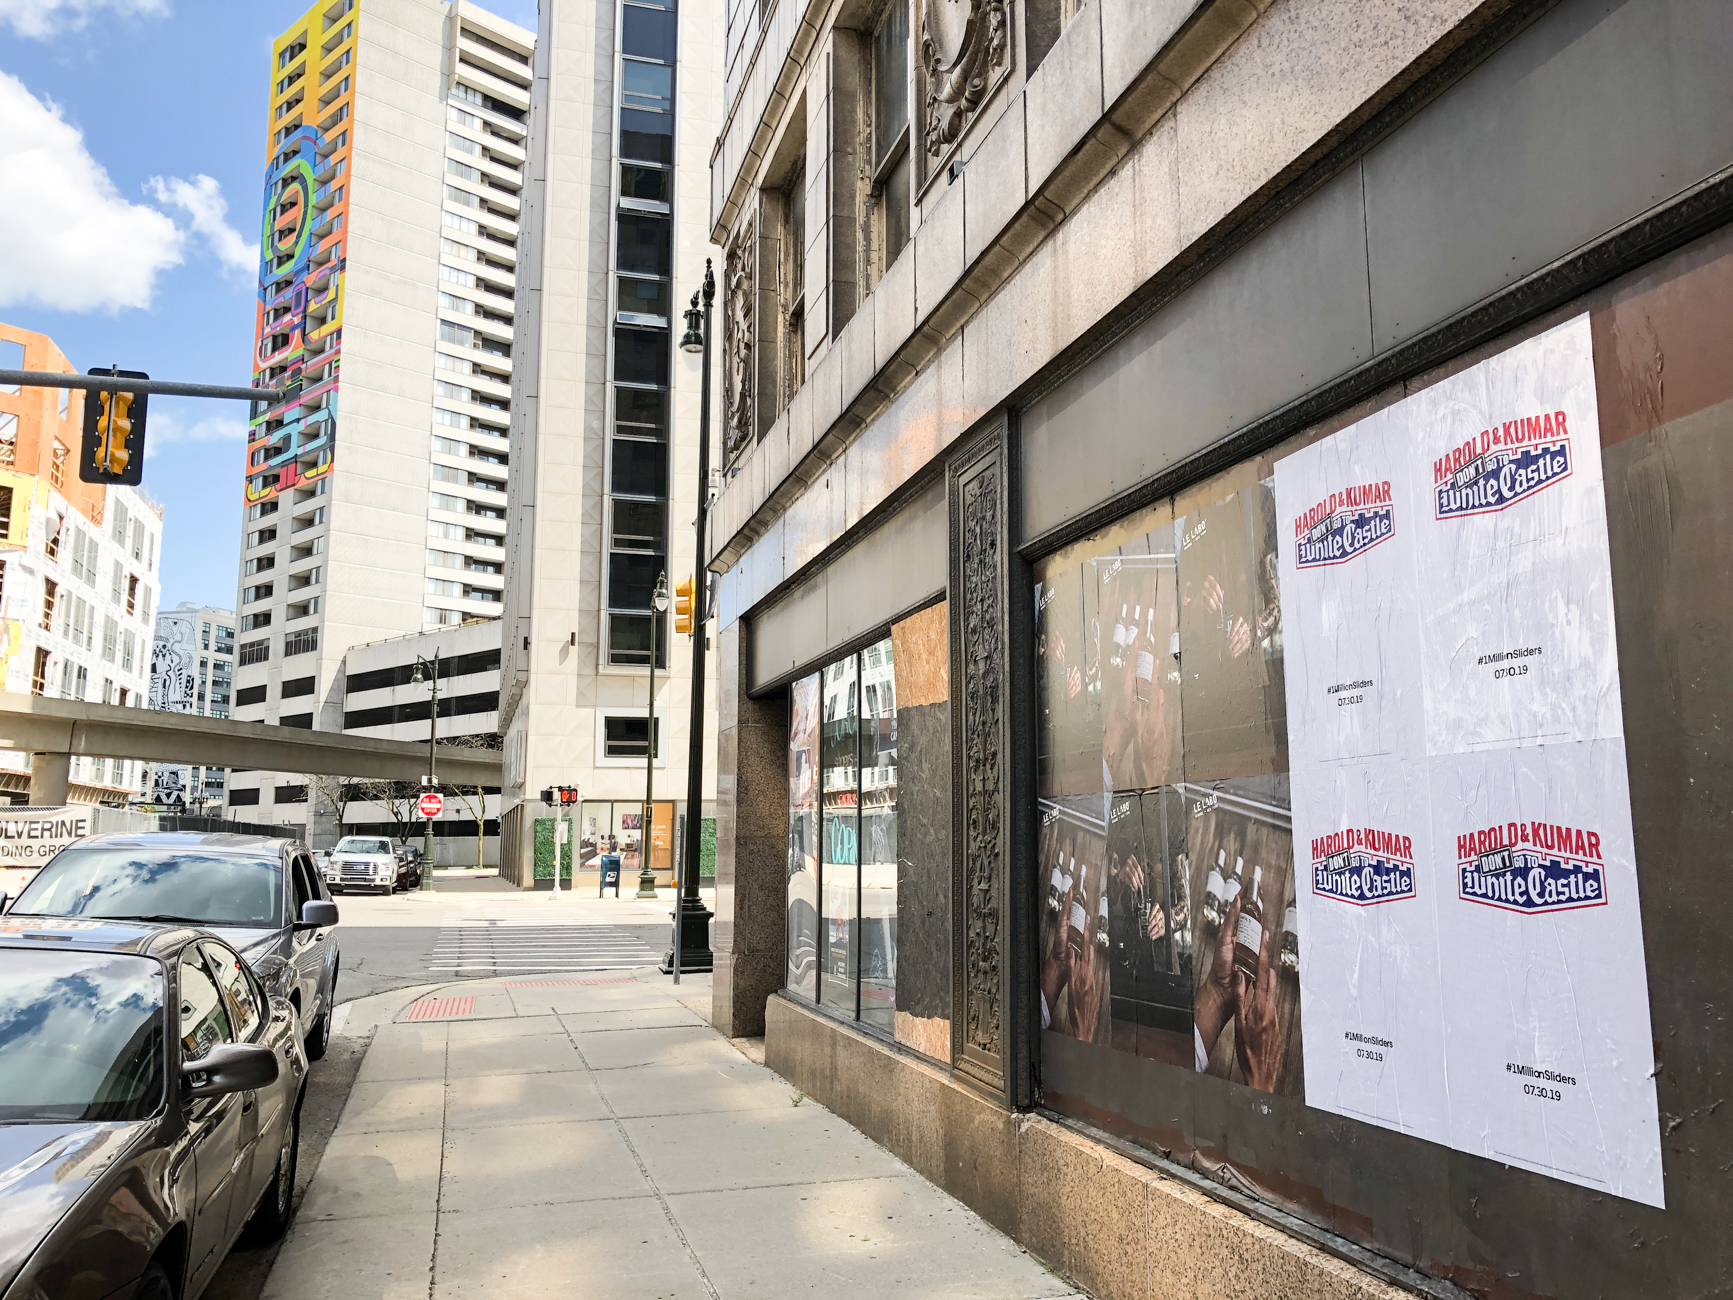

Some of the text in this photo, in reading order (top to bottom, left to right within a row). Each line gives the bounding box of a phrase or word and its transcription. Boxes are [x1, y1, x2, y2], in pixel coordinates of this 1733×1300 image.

[1434, 430, 1490, 484] HAROLD
[1502, 411, 1568, 446] KUMAR
[1456, 455, 1509, 486] DON'T GO TO
[1499, 454, 1565, 498] Castle
[1295, 493, 1337, 538] HAROLD
[1345, 480, 1392, 507] KUMAR
[1311, 517, 1331, 540] DON'T
[1343, 517, 1390, 553] Castle
[1494, 664, 1528, 679] 0730.19
[0, 819, 86, 839] LVERINE
[1312, 828, 1354, 860] HAROLD
[1364, 828, 1413, 860] KUMAR
[1457, 822, 1518, 860] HAROLD
[1531, 821, 1602, 860] KUMAR
[1329, 852, 1368, 870] DON'T GO TO
[1481, 851, 1538, 873] DON'T GO TO
[1361, 867, 1411, 898] Castle
[1527, 867, 1599, 905] Castle
[1357, 1048, 1383, 1062] 0730.19
[1506, 1063, 1577, 1085] #1MillionSliders
[1523, 1083, 1561, 1101] 07.30.19
